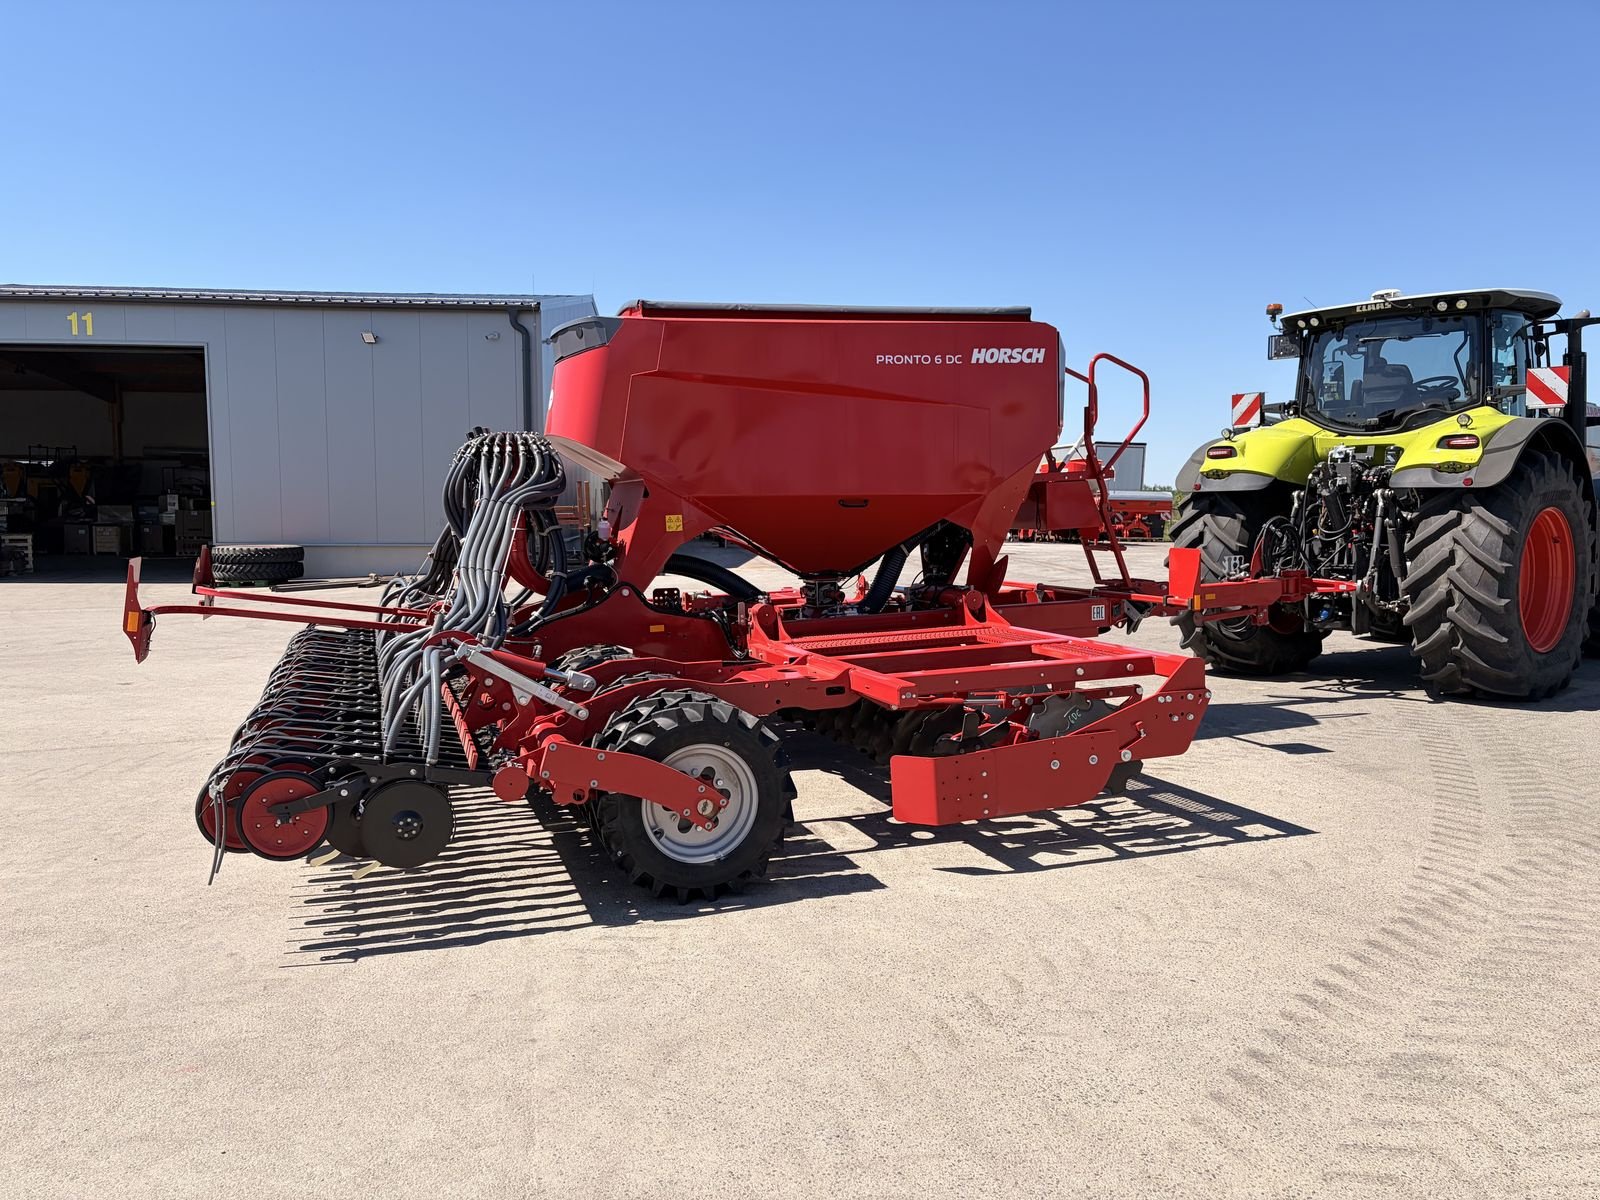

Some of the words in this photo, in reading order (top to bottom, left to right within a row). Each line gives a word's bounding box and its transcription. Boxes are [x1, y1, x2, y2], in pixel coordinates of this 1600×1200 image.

[1356, 302, 1392, 313] CLAAS
[66, 311, 93, 336] 11
[876, 354, 932, 365] PRONTO
[934, 354, 942, 365] 6
[946, 354, 963, 365] DC
[971, 347, 1046, 364] HORSCH
